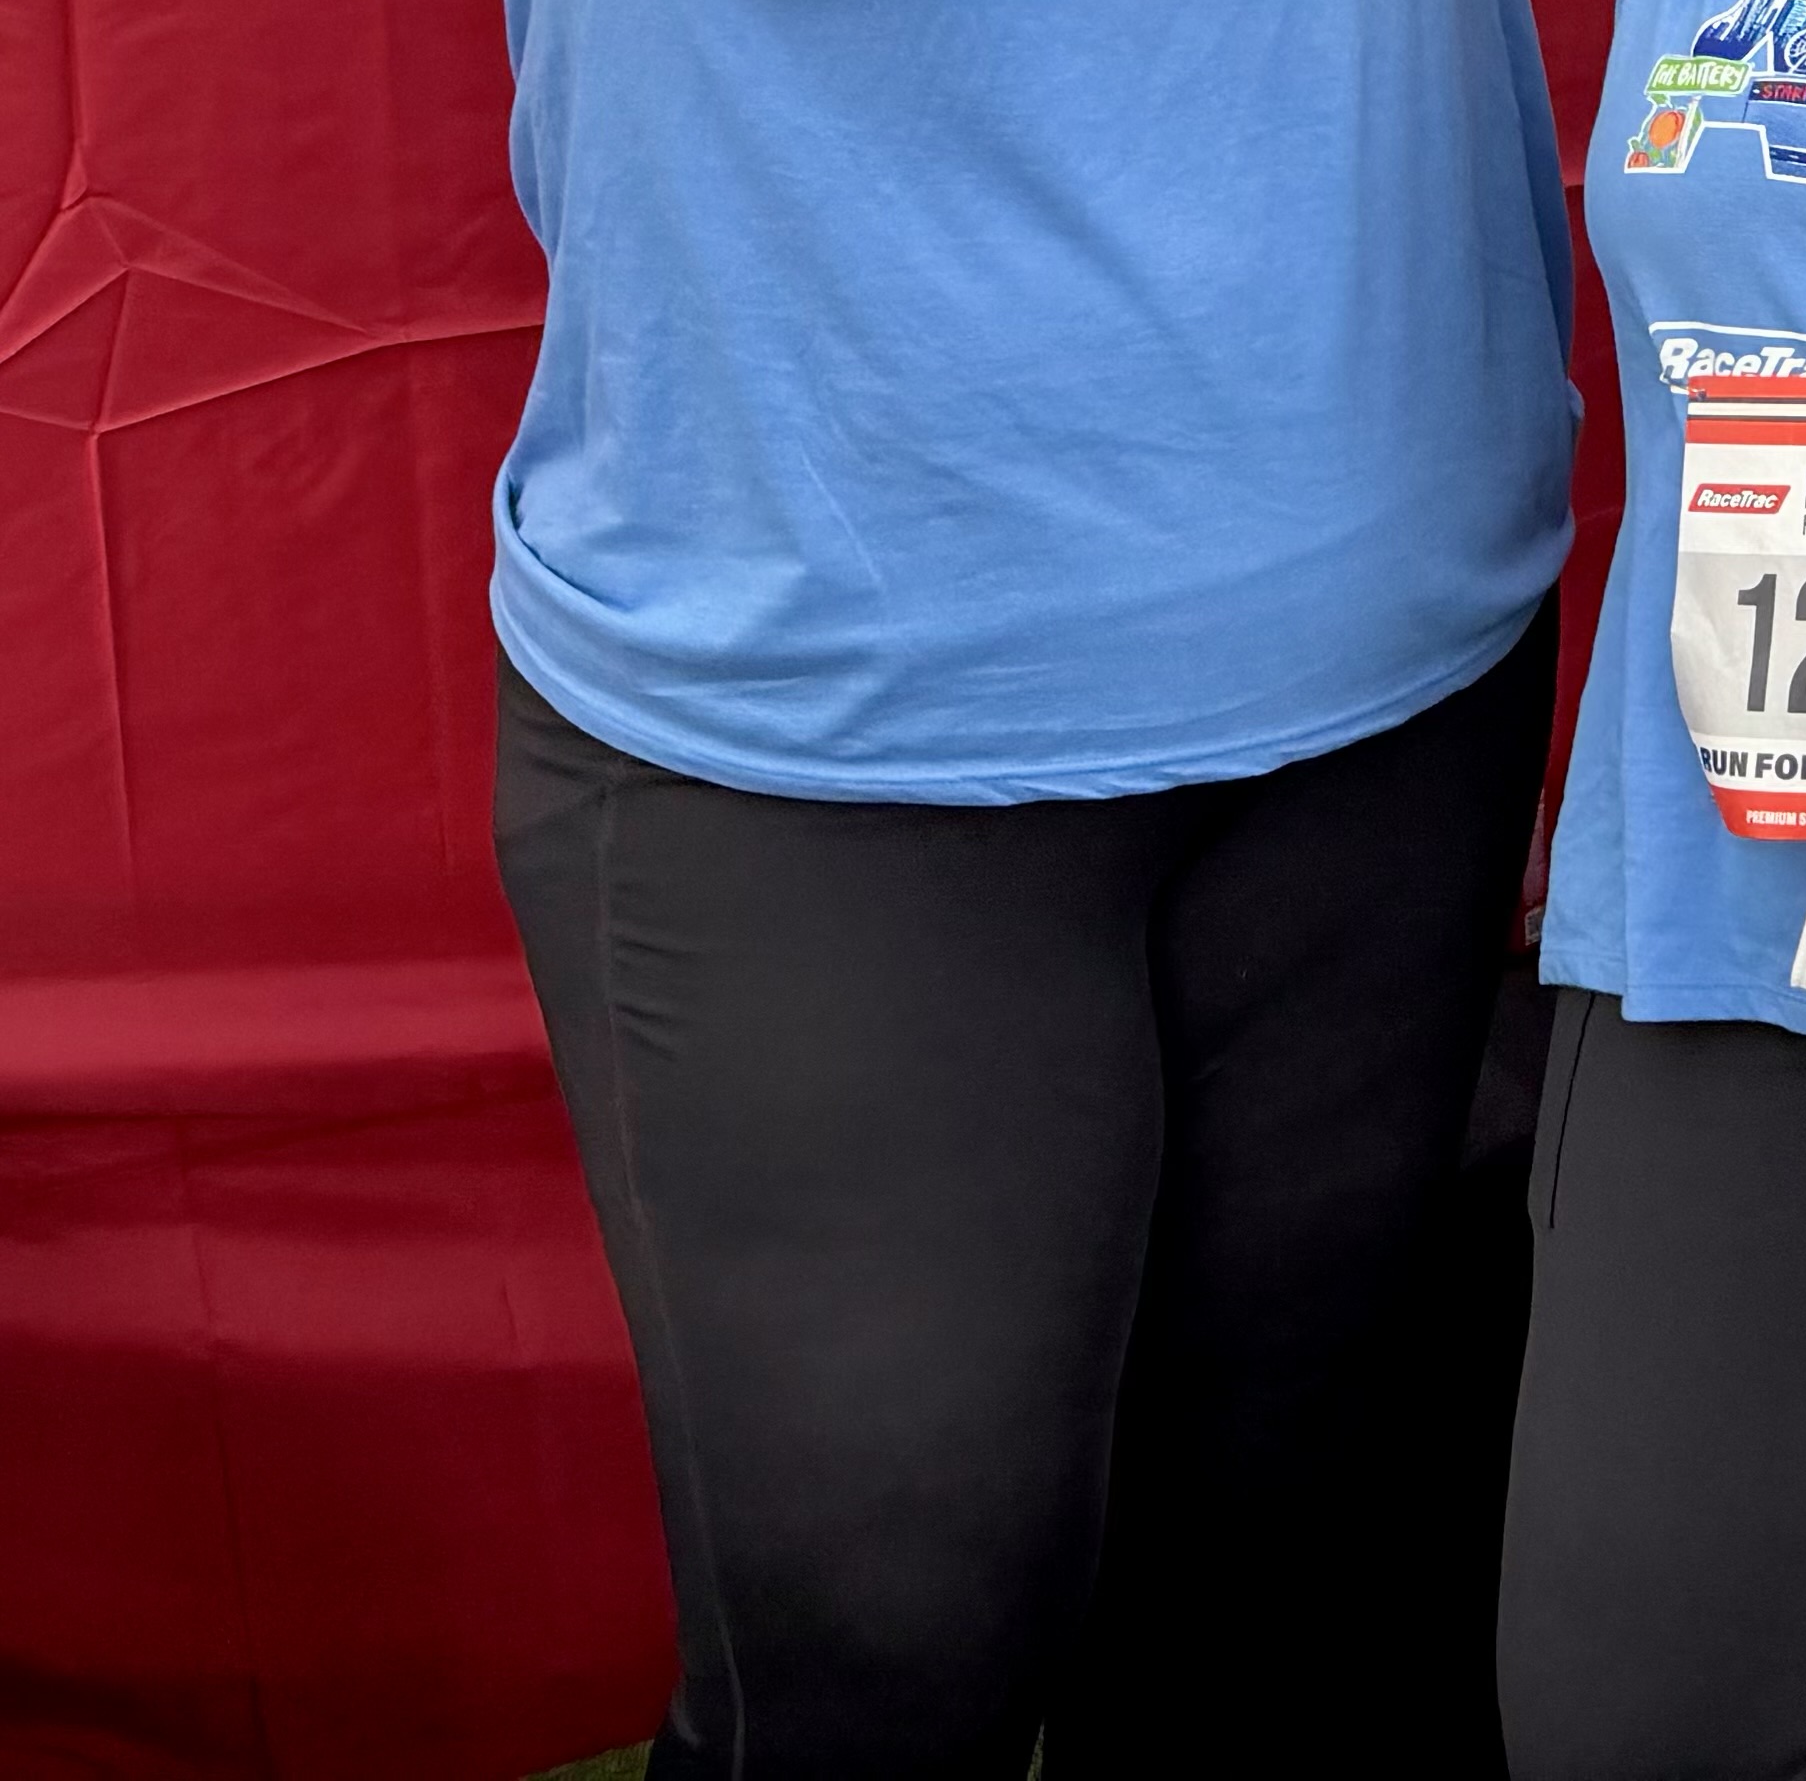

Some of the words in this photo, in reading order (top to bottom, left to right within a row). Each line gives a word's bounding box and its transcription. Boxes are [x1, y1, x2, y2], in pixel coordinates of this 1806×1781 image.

[1652, 64, 1681, 88] THE
[1681, 62, 1744, 92] BATTERY
[1697, 489, 1778, 509] RaceTrac
[1700, 747, 1748, 777] RUN
[1746, 810, 1797, 826] PREMIUM
